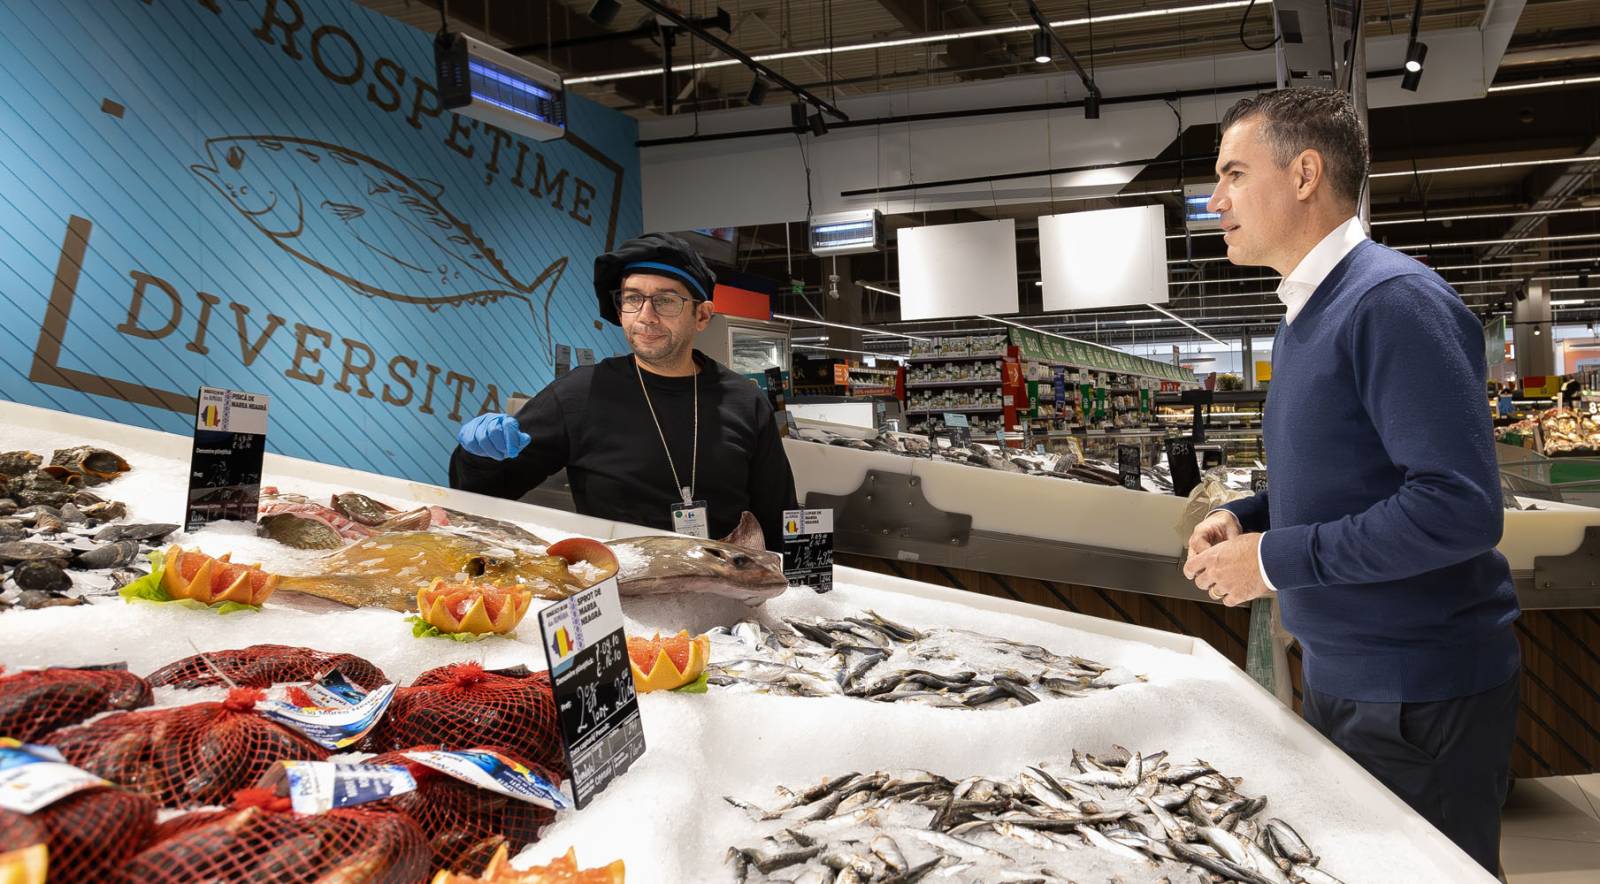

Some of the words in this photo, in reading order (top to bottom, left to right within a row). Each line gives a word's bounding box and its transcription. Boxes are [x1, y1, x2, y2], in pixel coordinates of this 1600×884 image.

[199, 0, 596, 226] ROSPEȚIME
[117, 270, 534, 423] DIVERSITA
[577, 591, 594, 606] SPROT
[594, 588, 602, 596] DE
[579, 601, 597, 616] MAREA
[581, 608, 602, 626] NEAGRĂ
